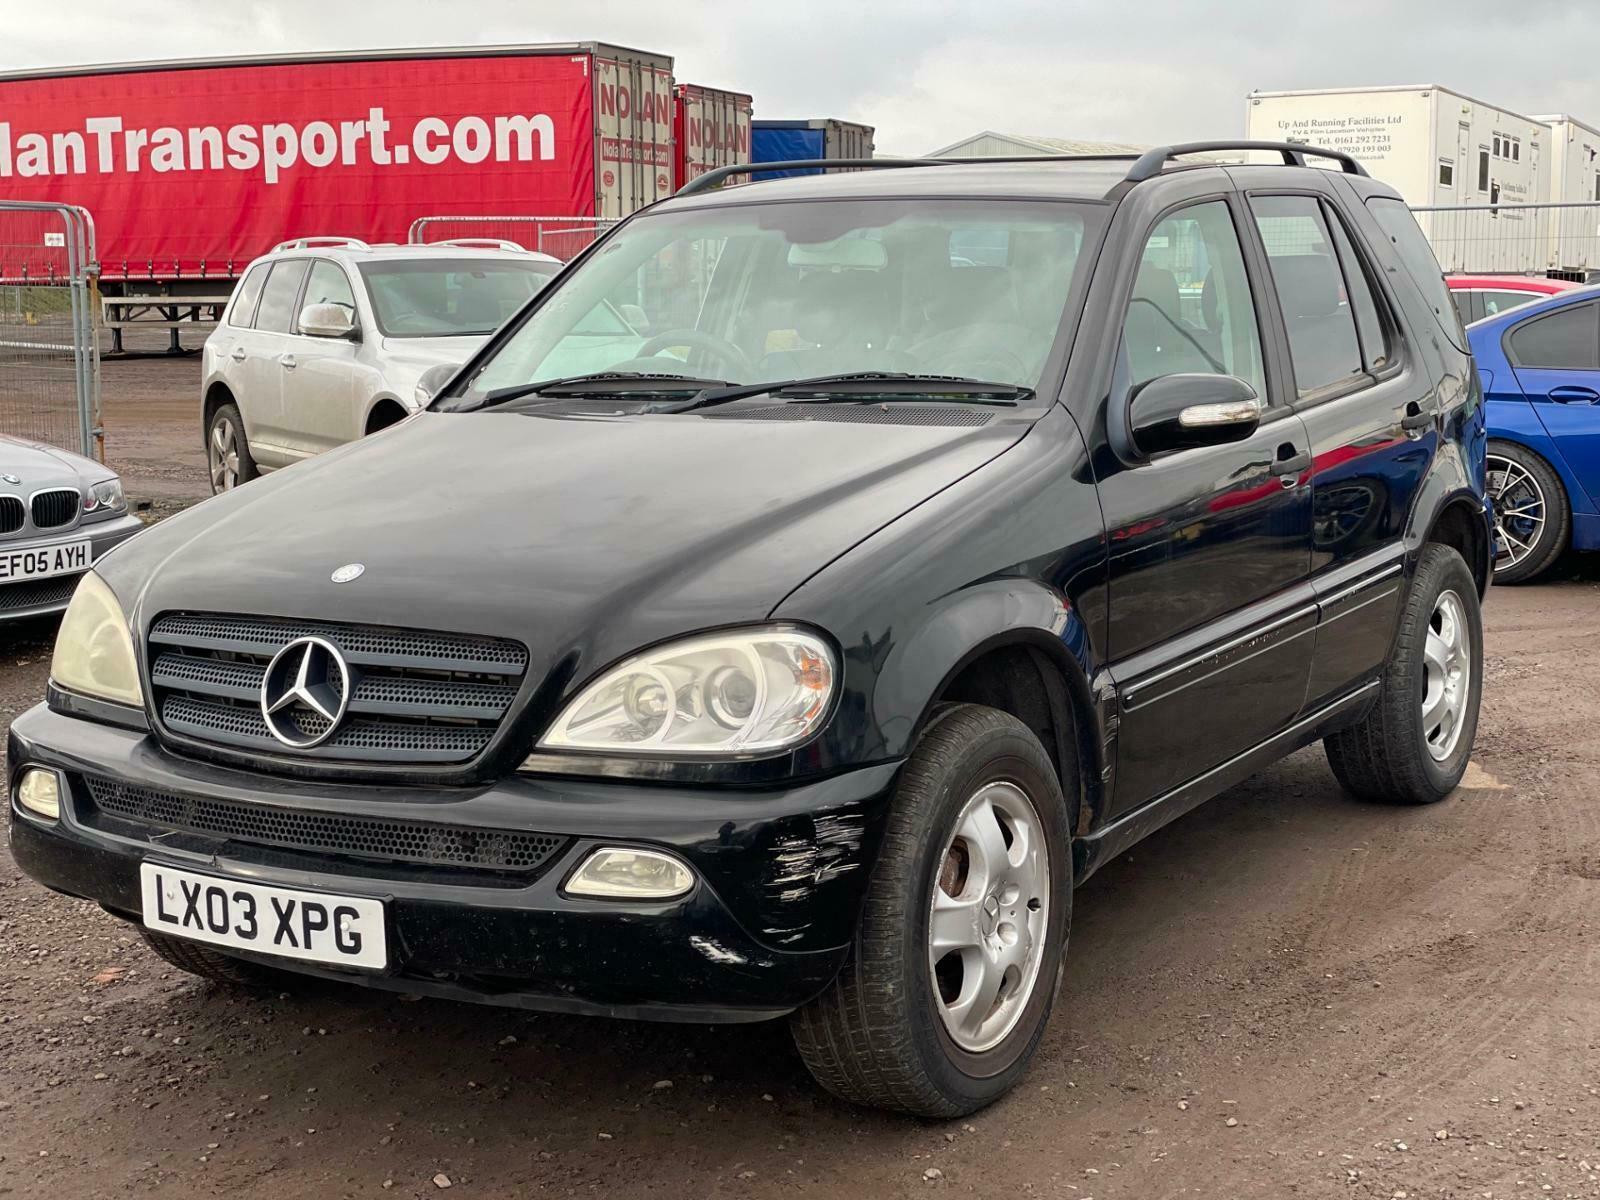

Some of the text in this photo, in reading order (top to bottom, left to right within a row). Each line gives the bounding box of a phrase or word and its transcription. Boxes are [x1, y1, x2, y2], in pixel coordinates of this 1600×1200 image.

[600, 82, 669, 126] NOLAN
[1278, 115, 1402, 130] Up And Running Facilities Ltd
[0, 106, 556, 184] lanTransport.com
[689, 117, 747, 154] NOLAN
[1335, 136, 1353, 144] 0161
[1372, 135, 1391, 143] 7231
[0, 545, 86, 578] EF05 AYH
[155, 873, 362, 956] LX03 XPG
